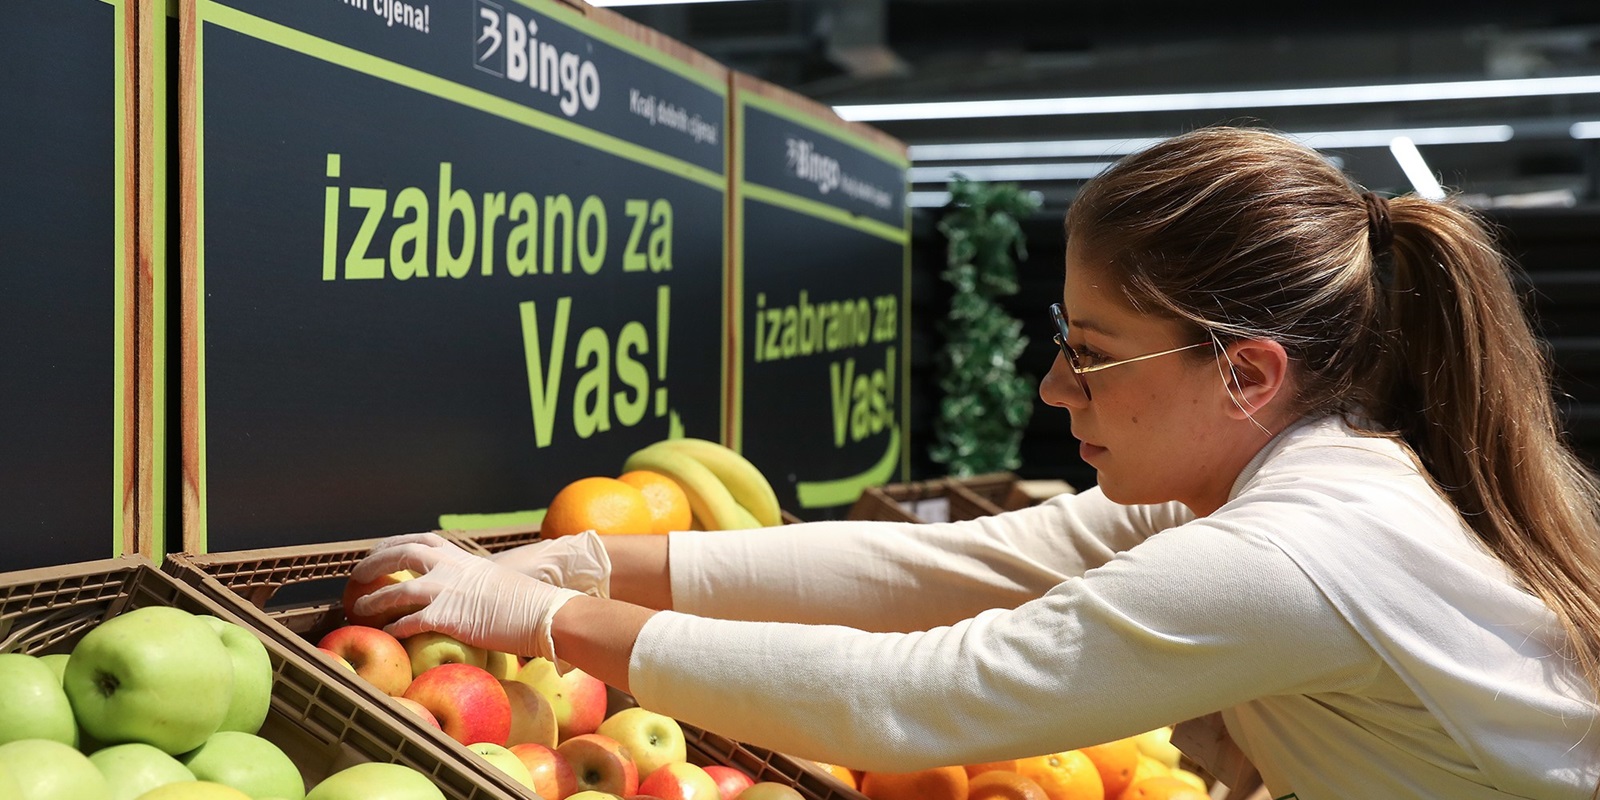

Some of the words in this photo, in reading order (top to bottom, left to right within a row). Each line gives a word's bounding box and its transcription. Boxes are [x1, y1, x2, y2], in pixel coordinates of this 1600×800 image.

[373, 0, 429, 34] cijena!
[506, 12, 600, 117] Bingo
[322, 153, 608, 281] izabrano
[622, 198, 673, 273] za
[519, 285, 671, 449] Vas!
[755, 289, 871, 363] izabrano
[872, 294, 898, 343] za
[830, 346, 897, 449] Vas!
